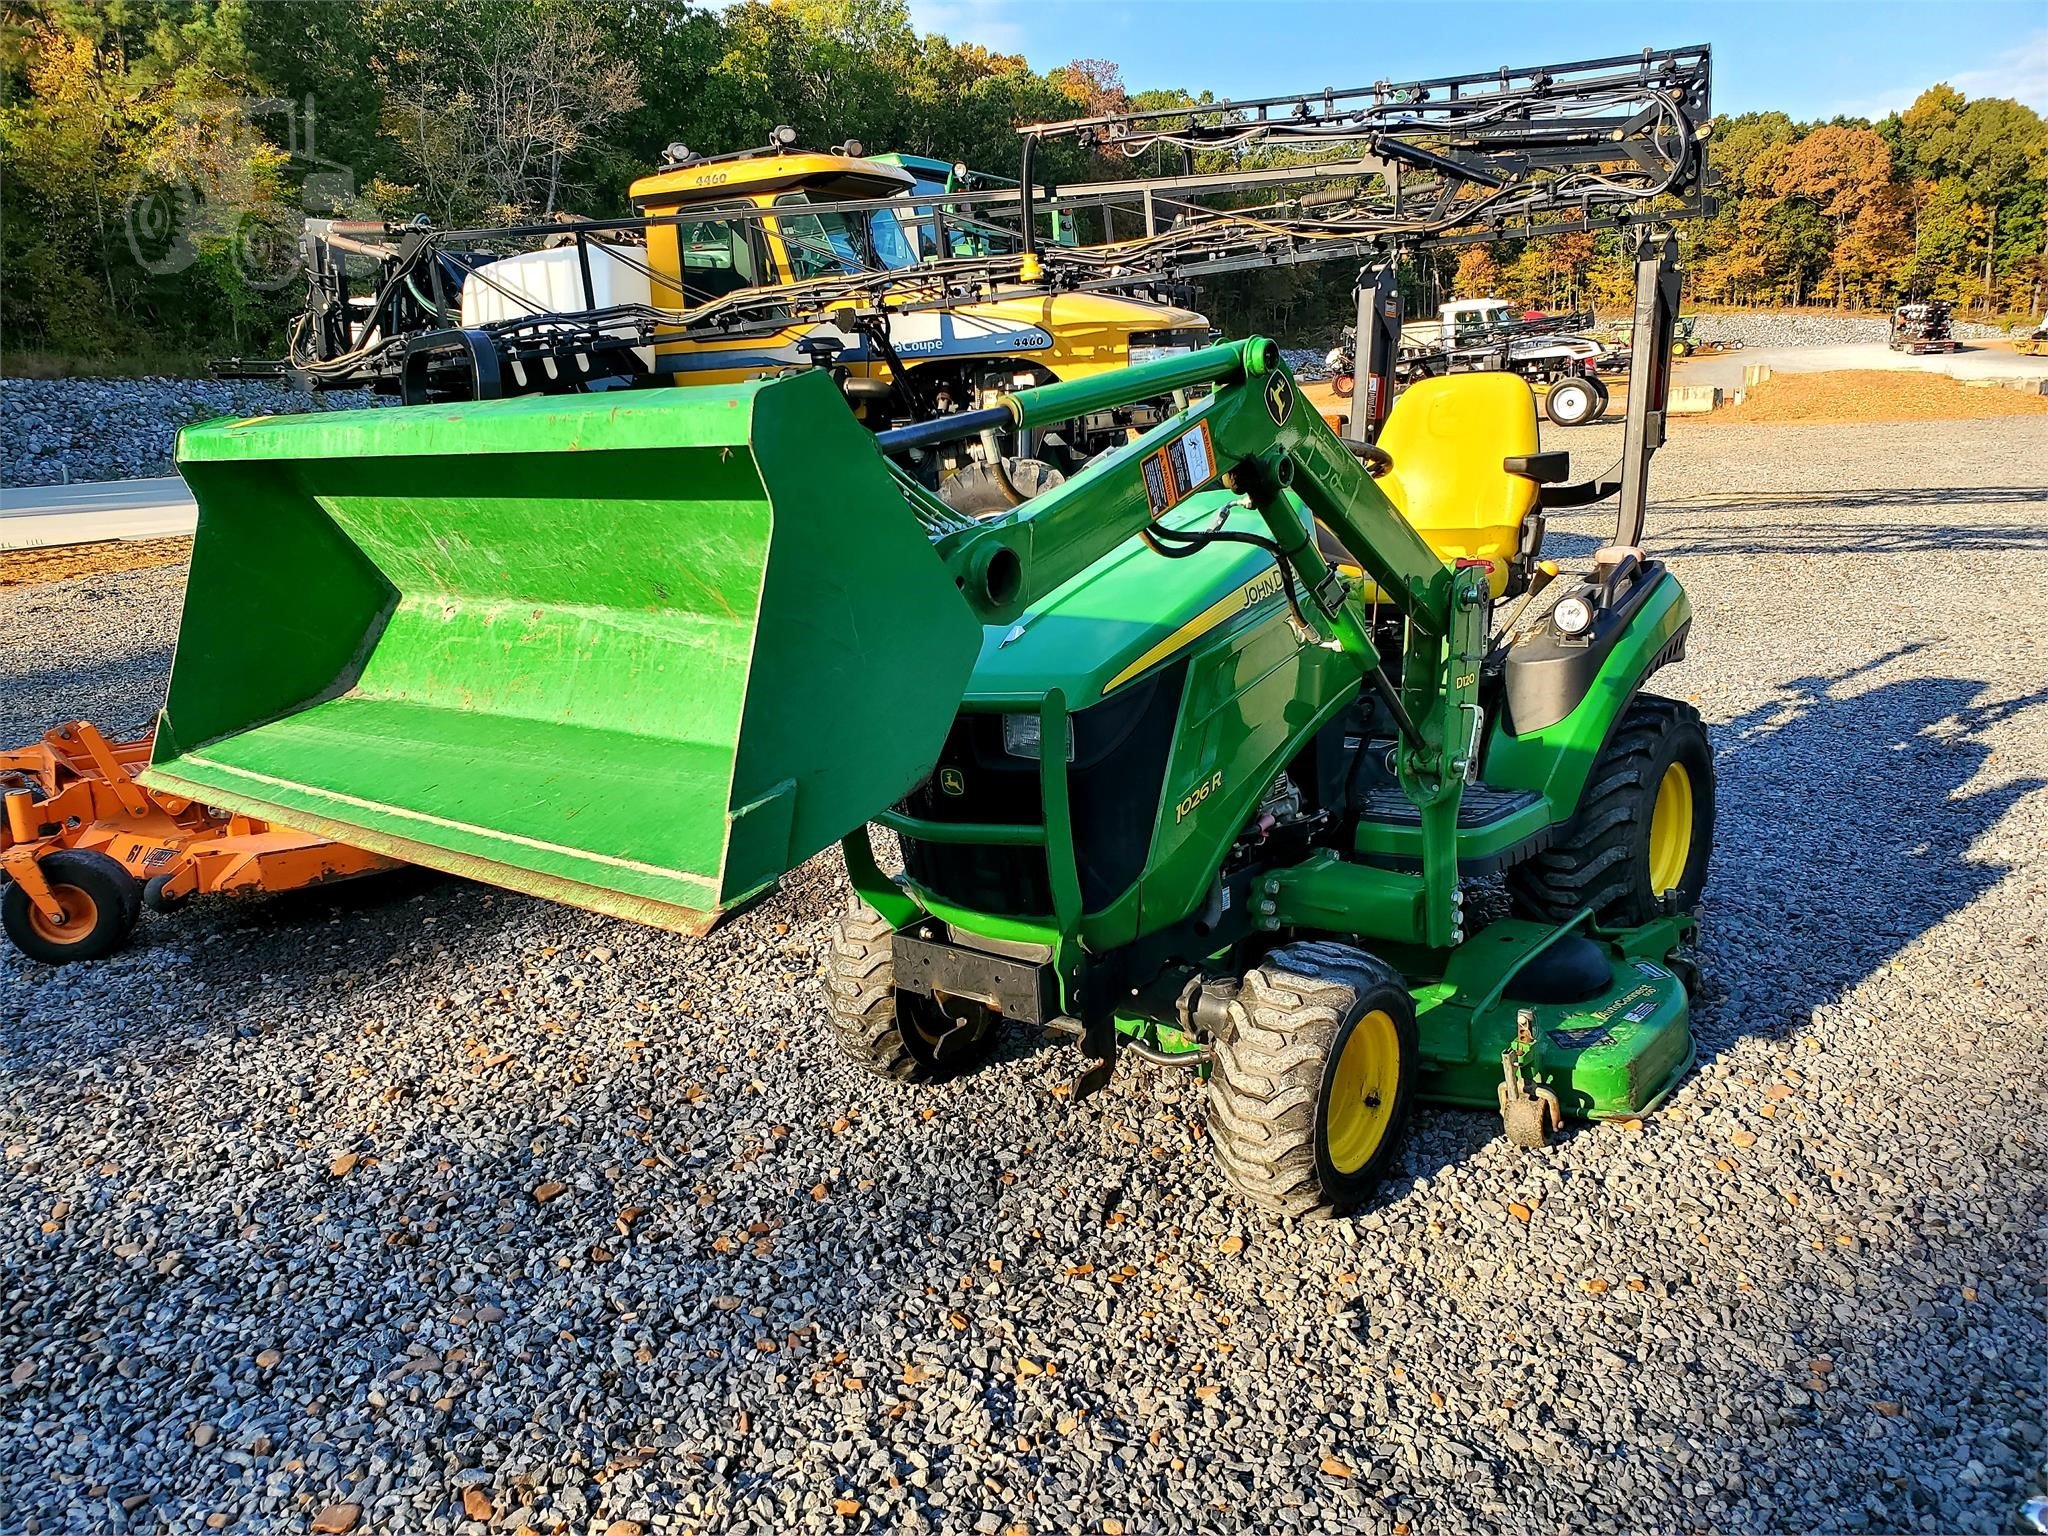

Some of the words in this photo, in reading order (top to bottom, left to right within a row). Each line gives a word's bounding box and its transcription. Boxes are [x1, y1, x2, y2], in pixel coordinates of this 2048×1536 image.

[696, 173, 727, 186] 4460
[894, 340, 943, 353] aCoupe
[1013, 336, 1045, 347] 4460
[1244, 578, 1274, 607] JOHN
[1456, 672, 1475, 690] D120
[1600, 984, 1652, 1020] AutoConnect
